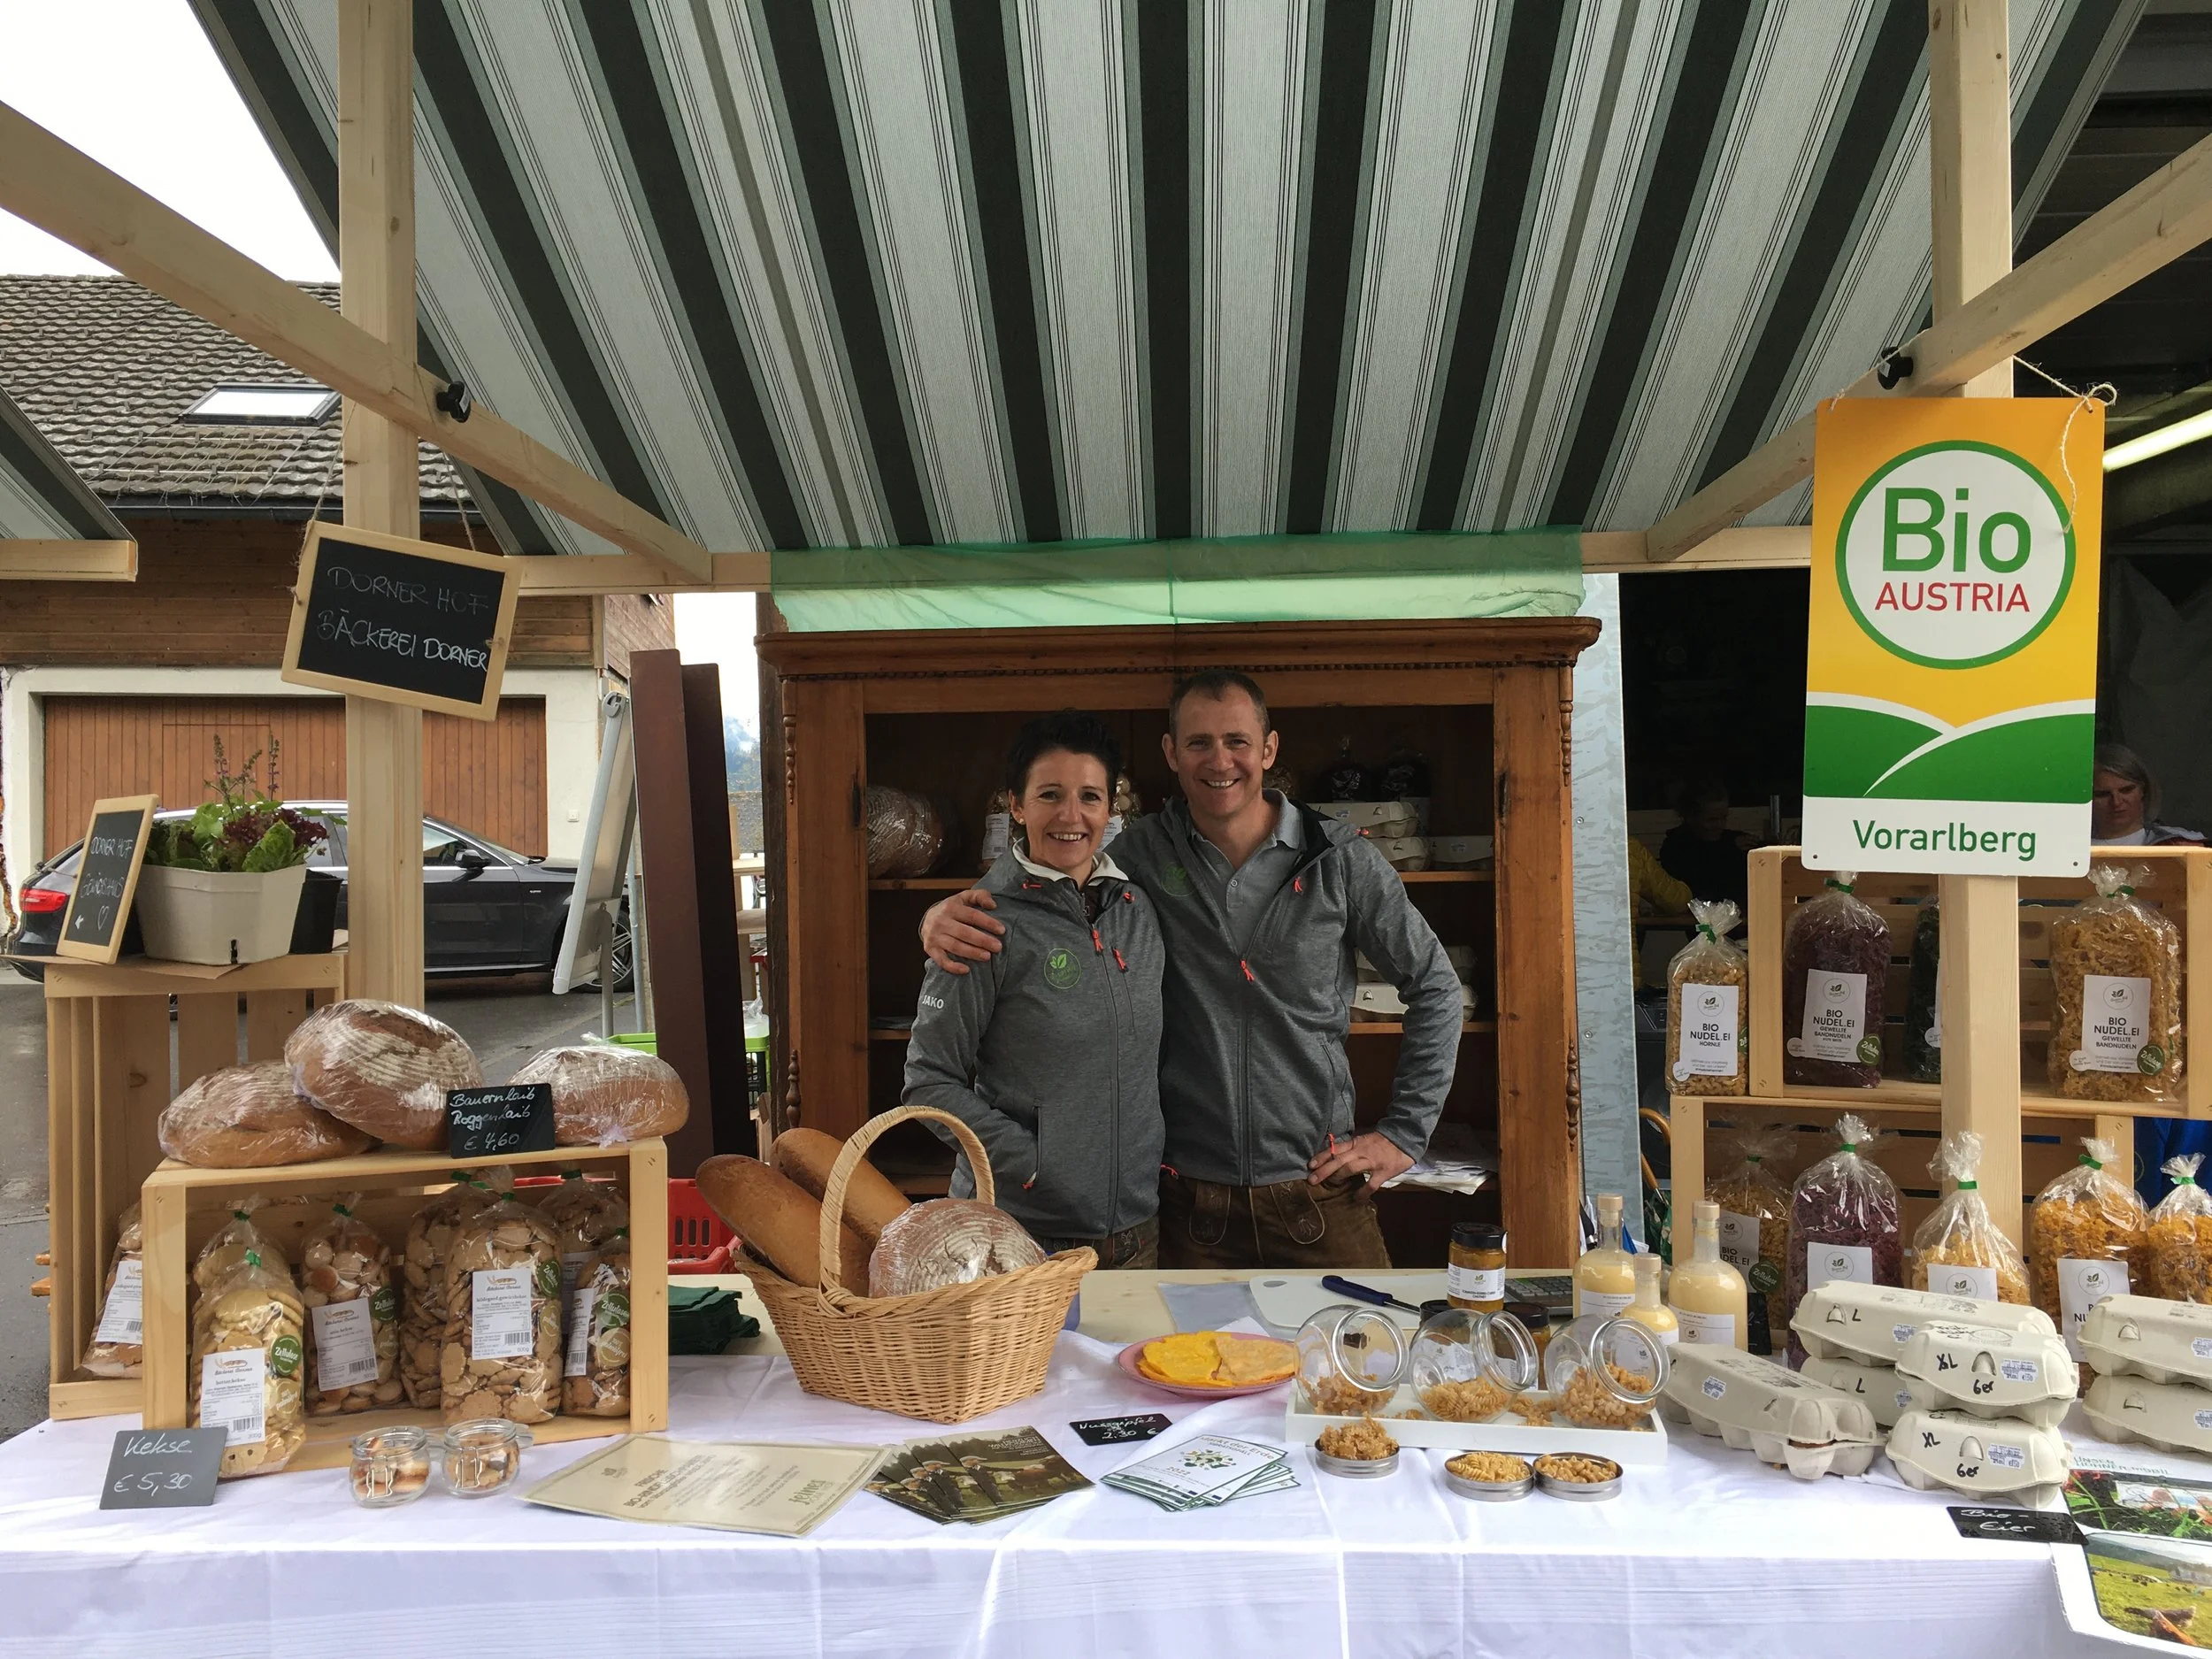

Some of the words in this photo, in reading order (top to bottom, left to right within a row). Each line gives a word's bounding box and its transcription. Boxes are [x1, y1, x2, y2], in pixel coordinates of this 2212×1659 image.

[1882, 487, 2032, 573] Bio
[327, 566, 428, 604] DORNER
[1875, 581, 2031, 612] AUSTRIA
[316, 608, 417, 657] BÄCKEREI
[423, 637, 488, 672] DORNER
[1853, 819, 2037, 861] Vorarlberg
[922, 995, 944, 1010] JAKO
[1702, 1023, 1719, 1032] BIO
[1813, 1017, 1855, 1027] NUDEL.EI
[2108, 1018, 2127, 1026] BIO
[1690, 1031, 1731, 1041] NUDEL.EI
[2093, 1025, 2140, 1036] NUDEL.EI
[2095, 1041, 2137, 1050] BANDNUDELN
[449, 1087, 535, 1108] Bauernlaib
[450, 1104, 531, 1132] Roggenlaib
[464, 1136, 478, 1150] €
[485, 1132, 520, 1150] 4,60
[1722, 1246, 1738, 1255] BIO
[1719, 1254, 1750, 1266] DEL.EI
[1852, 1309, 1862, 1322] L
[274, 1346, 299, 1361] Zellulose
[1855, 1378, 1866, 1393] L
[1972, 1379, 1994, 1394] 6er
[124, 1432, 193, 1457] Kekse
[1922, 1432, 1941, 1448] XL
[1166, 1466, 1191, 1476] 2022
[1956, 1463, 1979, 1478] 6er
[114, 1474, 133, 1493] €
[137, 1471, 193, 1497] 5,30
[1960, 1509, 2012, 1518] Bio
[1979, 1520, 2036, 1532] Eier
